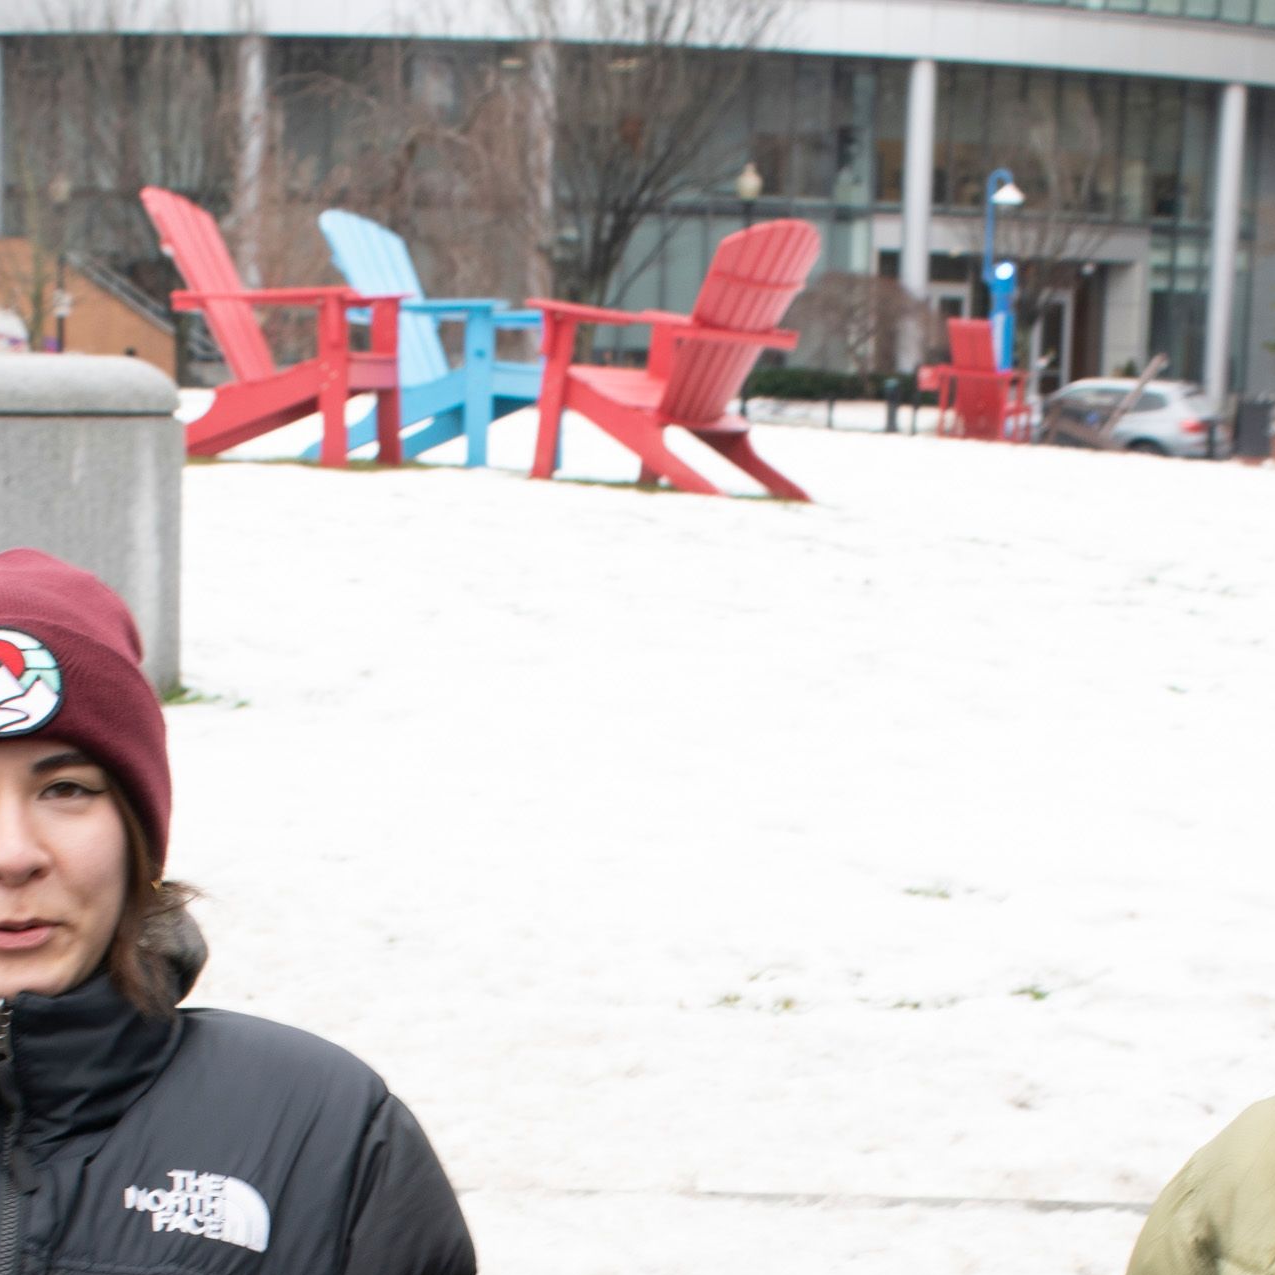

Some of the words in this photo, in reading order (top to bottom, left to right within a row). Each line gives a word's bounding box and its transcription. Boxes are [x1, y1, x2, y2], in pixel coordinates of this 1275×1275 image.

[166, 1169, 226, 1197] THE
[124, 1185, 227, 1222] NORTH
[152, 1212, 226, 1240] FACE
